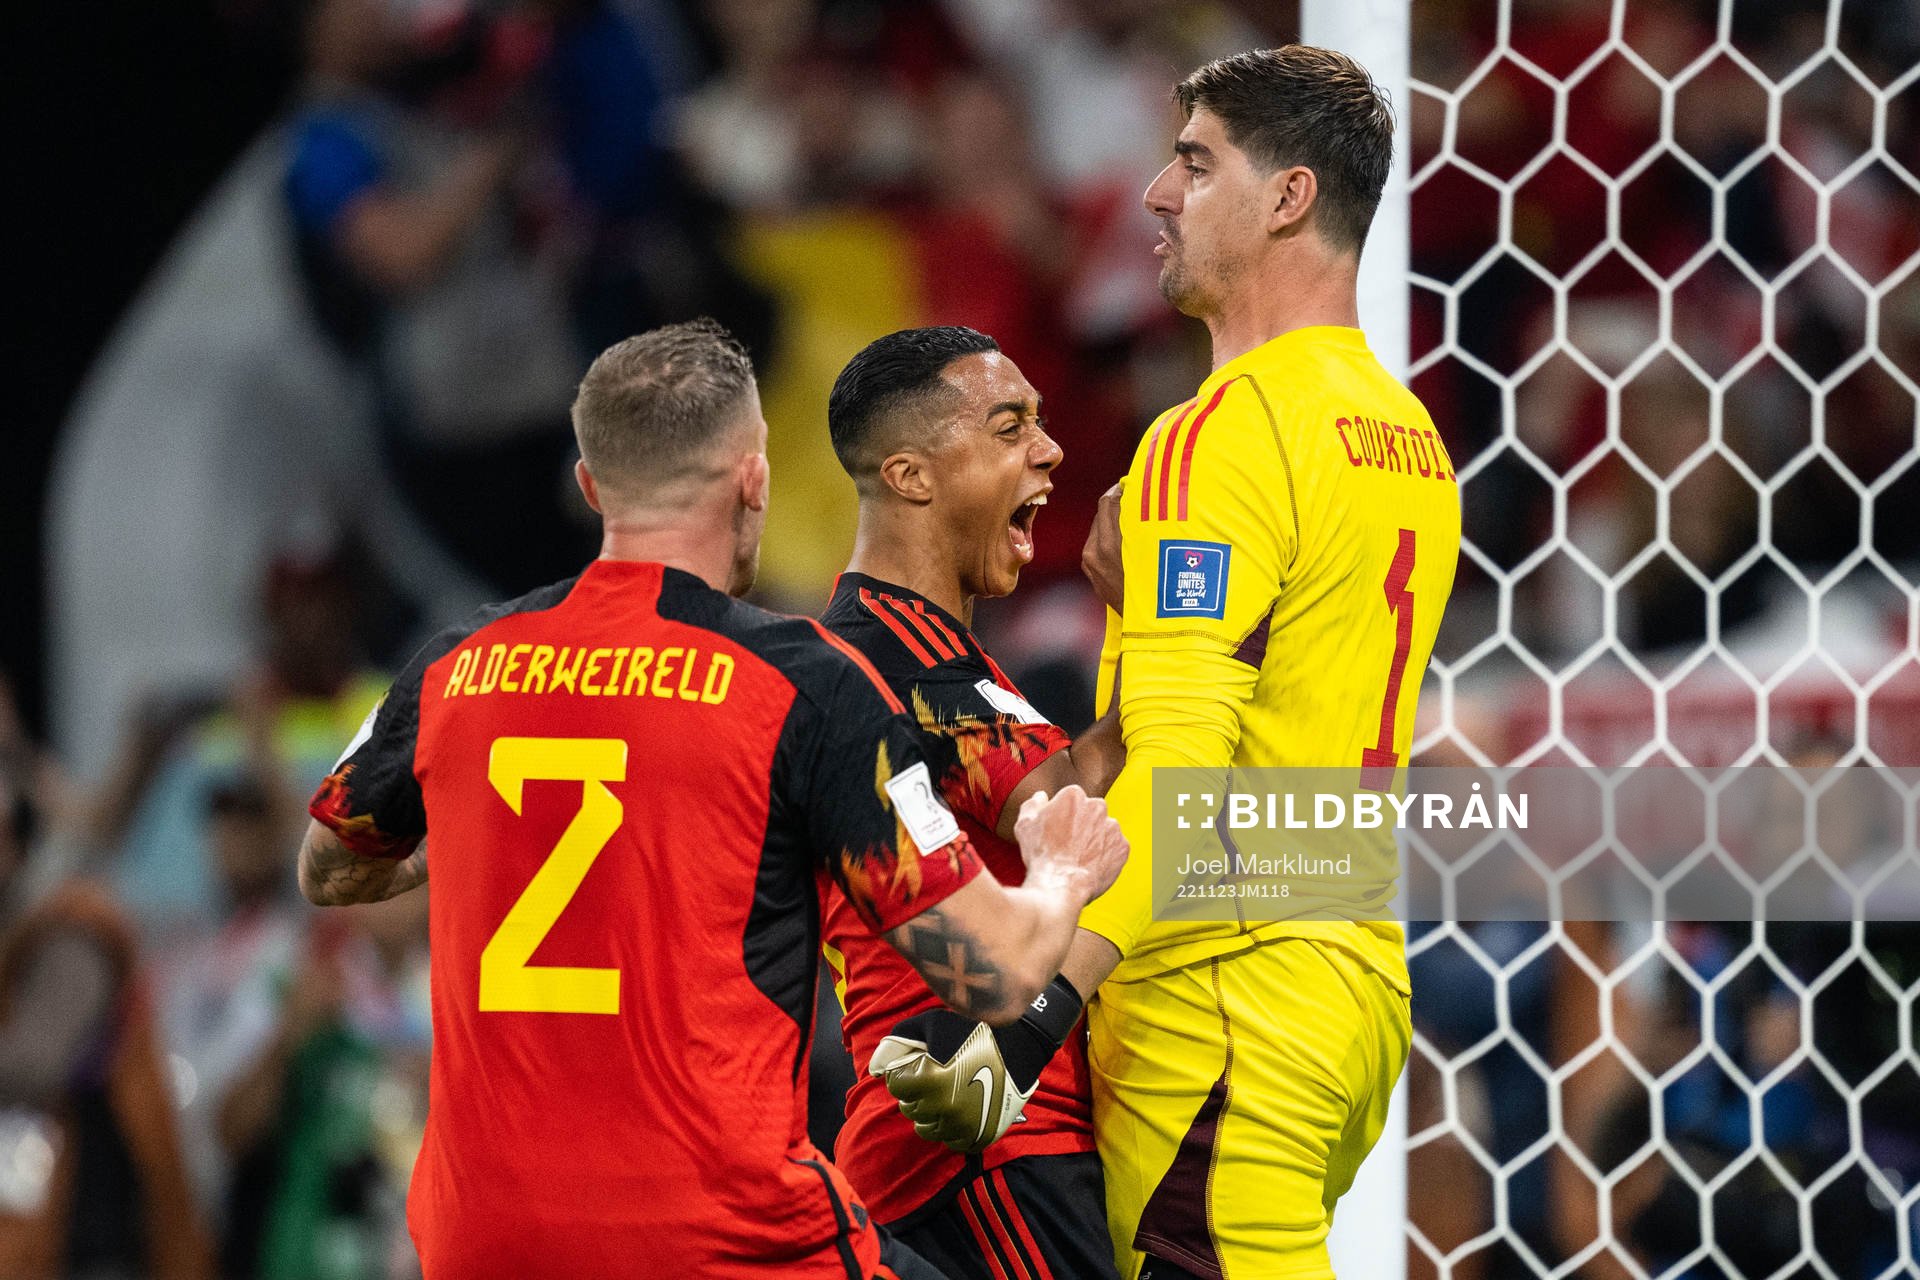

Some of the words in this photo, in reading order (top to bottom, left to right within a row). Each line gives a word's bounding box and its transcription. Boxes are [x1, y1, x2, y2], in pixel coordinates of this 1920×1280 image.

[1178, 571, 1205, 579] FOOTBALL
[1178, 579, 1205, 589] UNITES
[443, 643, 735, 705] ALDERWEIRELD
[1359, 528, 1416, 792] 1
[479, 737, 629, 1015] 2
